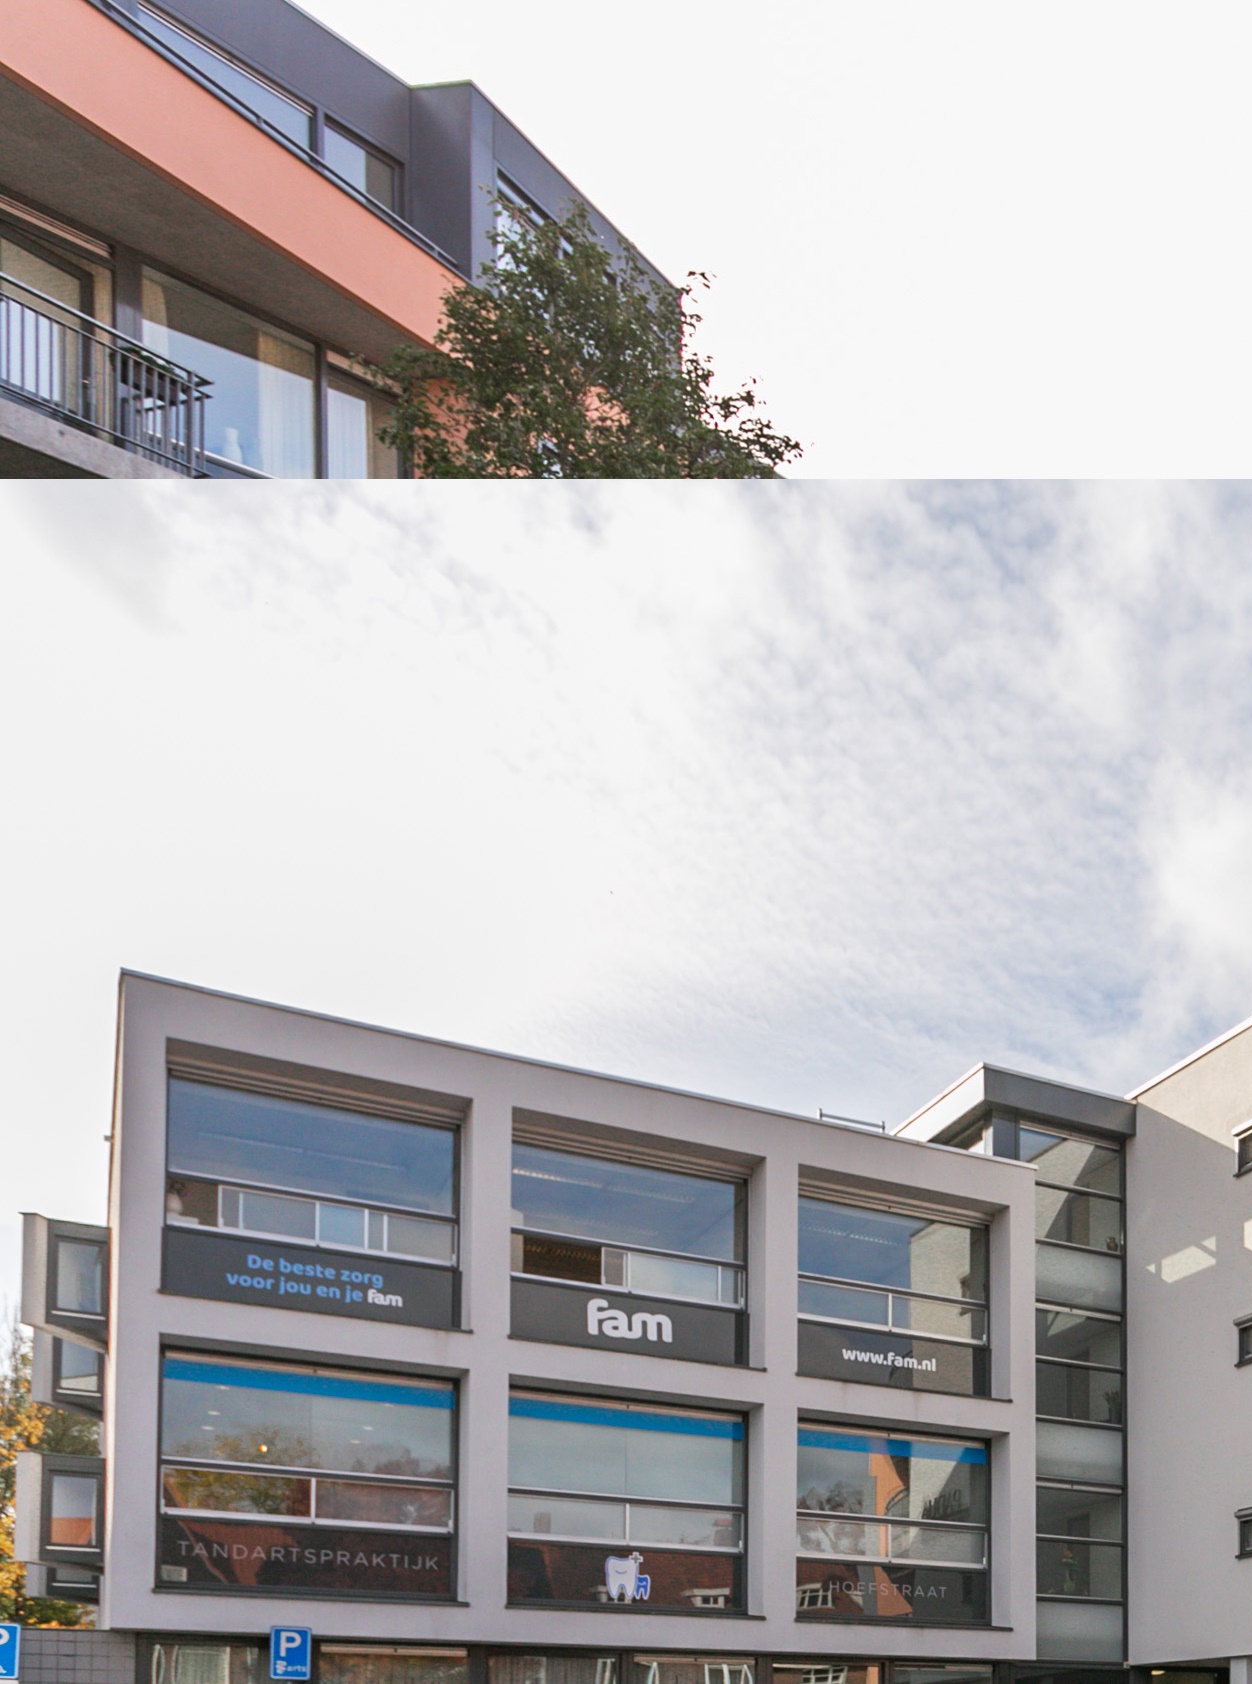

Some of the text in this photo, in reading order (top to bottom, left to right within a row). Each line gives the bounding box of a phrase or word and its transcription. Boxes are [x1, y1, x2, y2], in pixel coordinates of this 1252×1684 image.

[246, 1254, 384, 1289] De beste zorg
[225, 1272, 403, 1308] voor jou en je fam
[587, 1298, 673, 1343] fam
[841, 1348, 937, 1372] www.fam.nl
[176, 1540, 439, 1571] TANDARTSPRAKTIJK
[828, 1580, 948, 1599] HOEFSTRAAT
[279, 1631, 302, 1658] P
